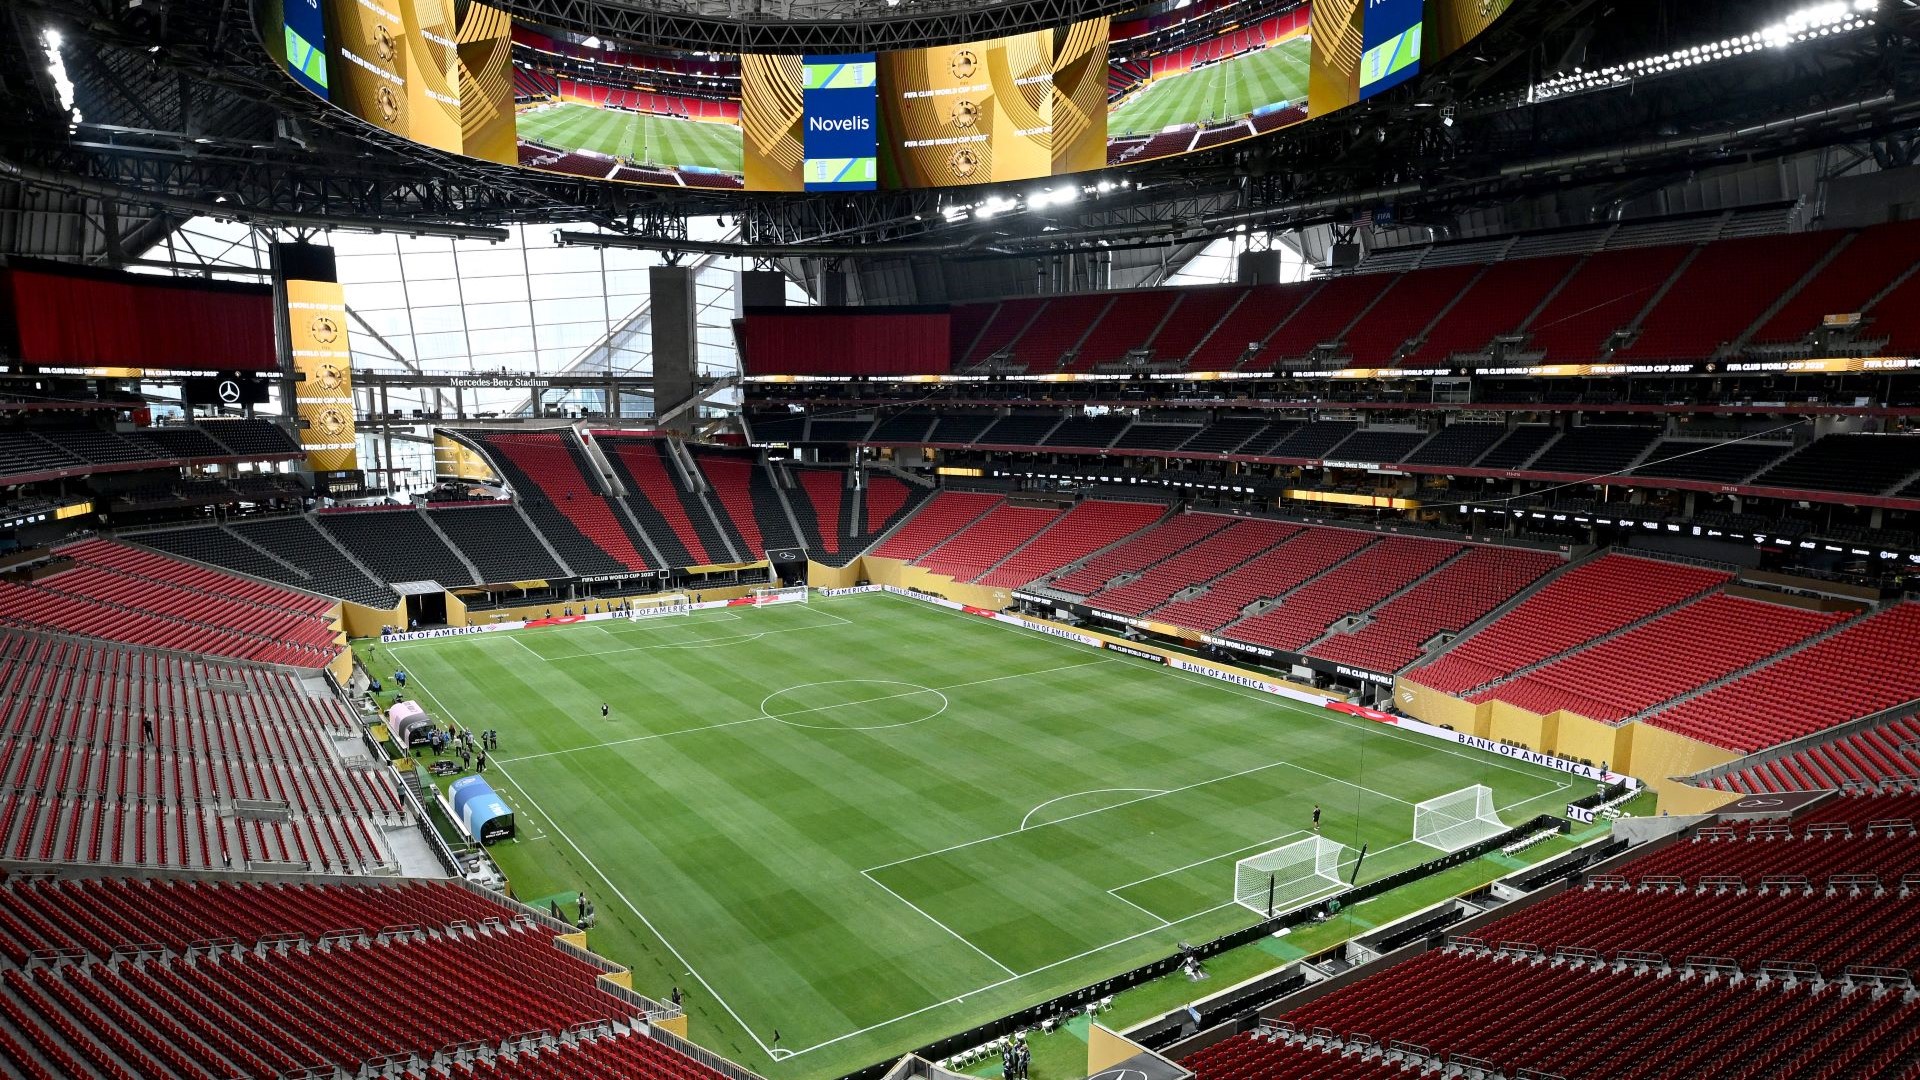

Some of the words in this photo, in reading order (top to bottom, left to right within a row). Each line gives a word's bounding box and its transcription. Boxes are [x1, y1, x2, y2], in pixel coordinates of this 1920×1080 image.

[810, 116, 870, 131] Novelis
[450, 378, 513, 387] Mercedes-Benz
[515, 378, 550, 387] Stadium
[837, 586, 870, 594] AMERICA
[384, 633, 414, 642] BANK
[434, 626, 482, 637] AMERICA
[1023, 620, 1040, 630] BANK
[1052, 630, 1082, 642] AMERICA
[1212, 638, 1226, 646] CLUB
[1226, 640, 1245, 650] WORLD
[1182, 662, 1206, 674] BANK
[1208, 669, 1220, 678] OF
[1222, 674, 1264, 690] AMERICA
[1337, 666, 1350, 675] FIFA
[1352, 670, 1368, 680] CLUB
[1458, 734, 1494, 752] BANK
[1500, 745, 1518, 757] OF
[1522, 751, 1592, 778] AMERICA
